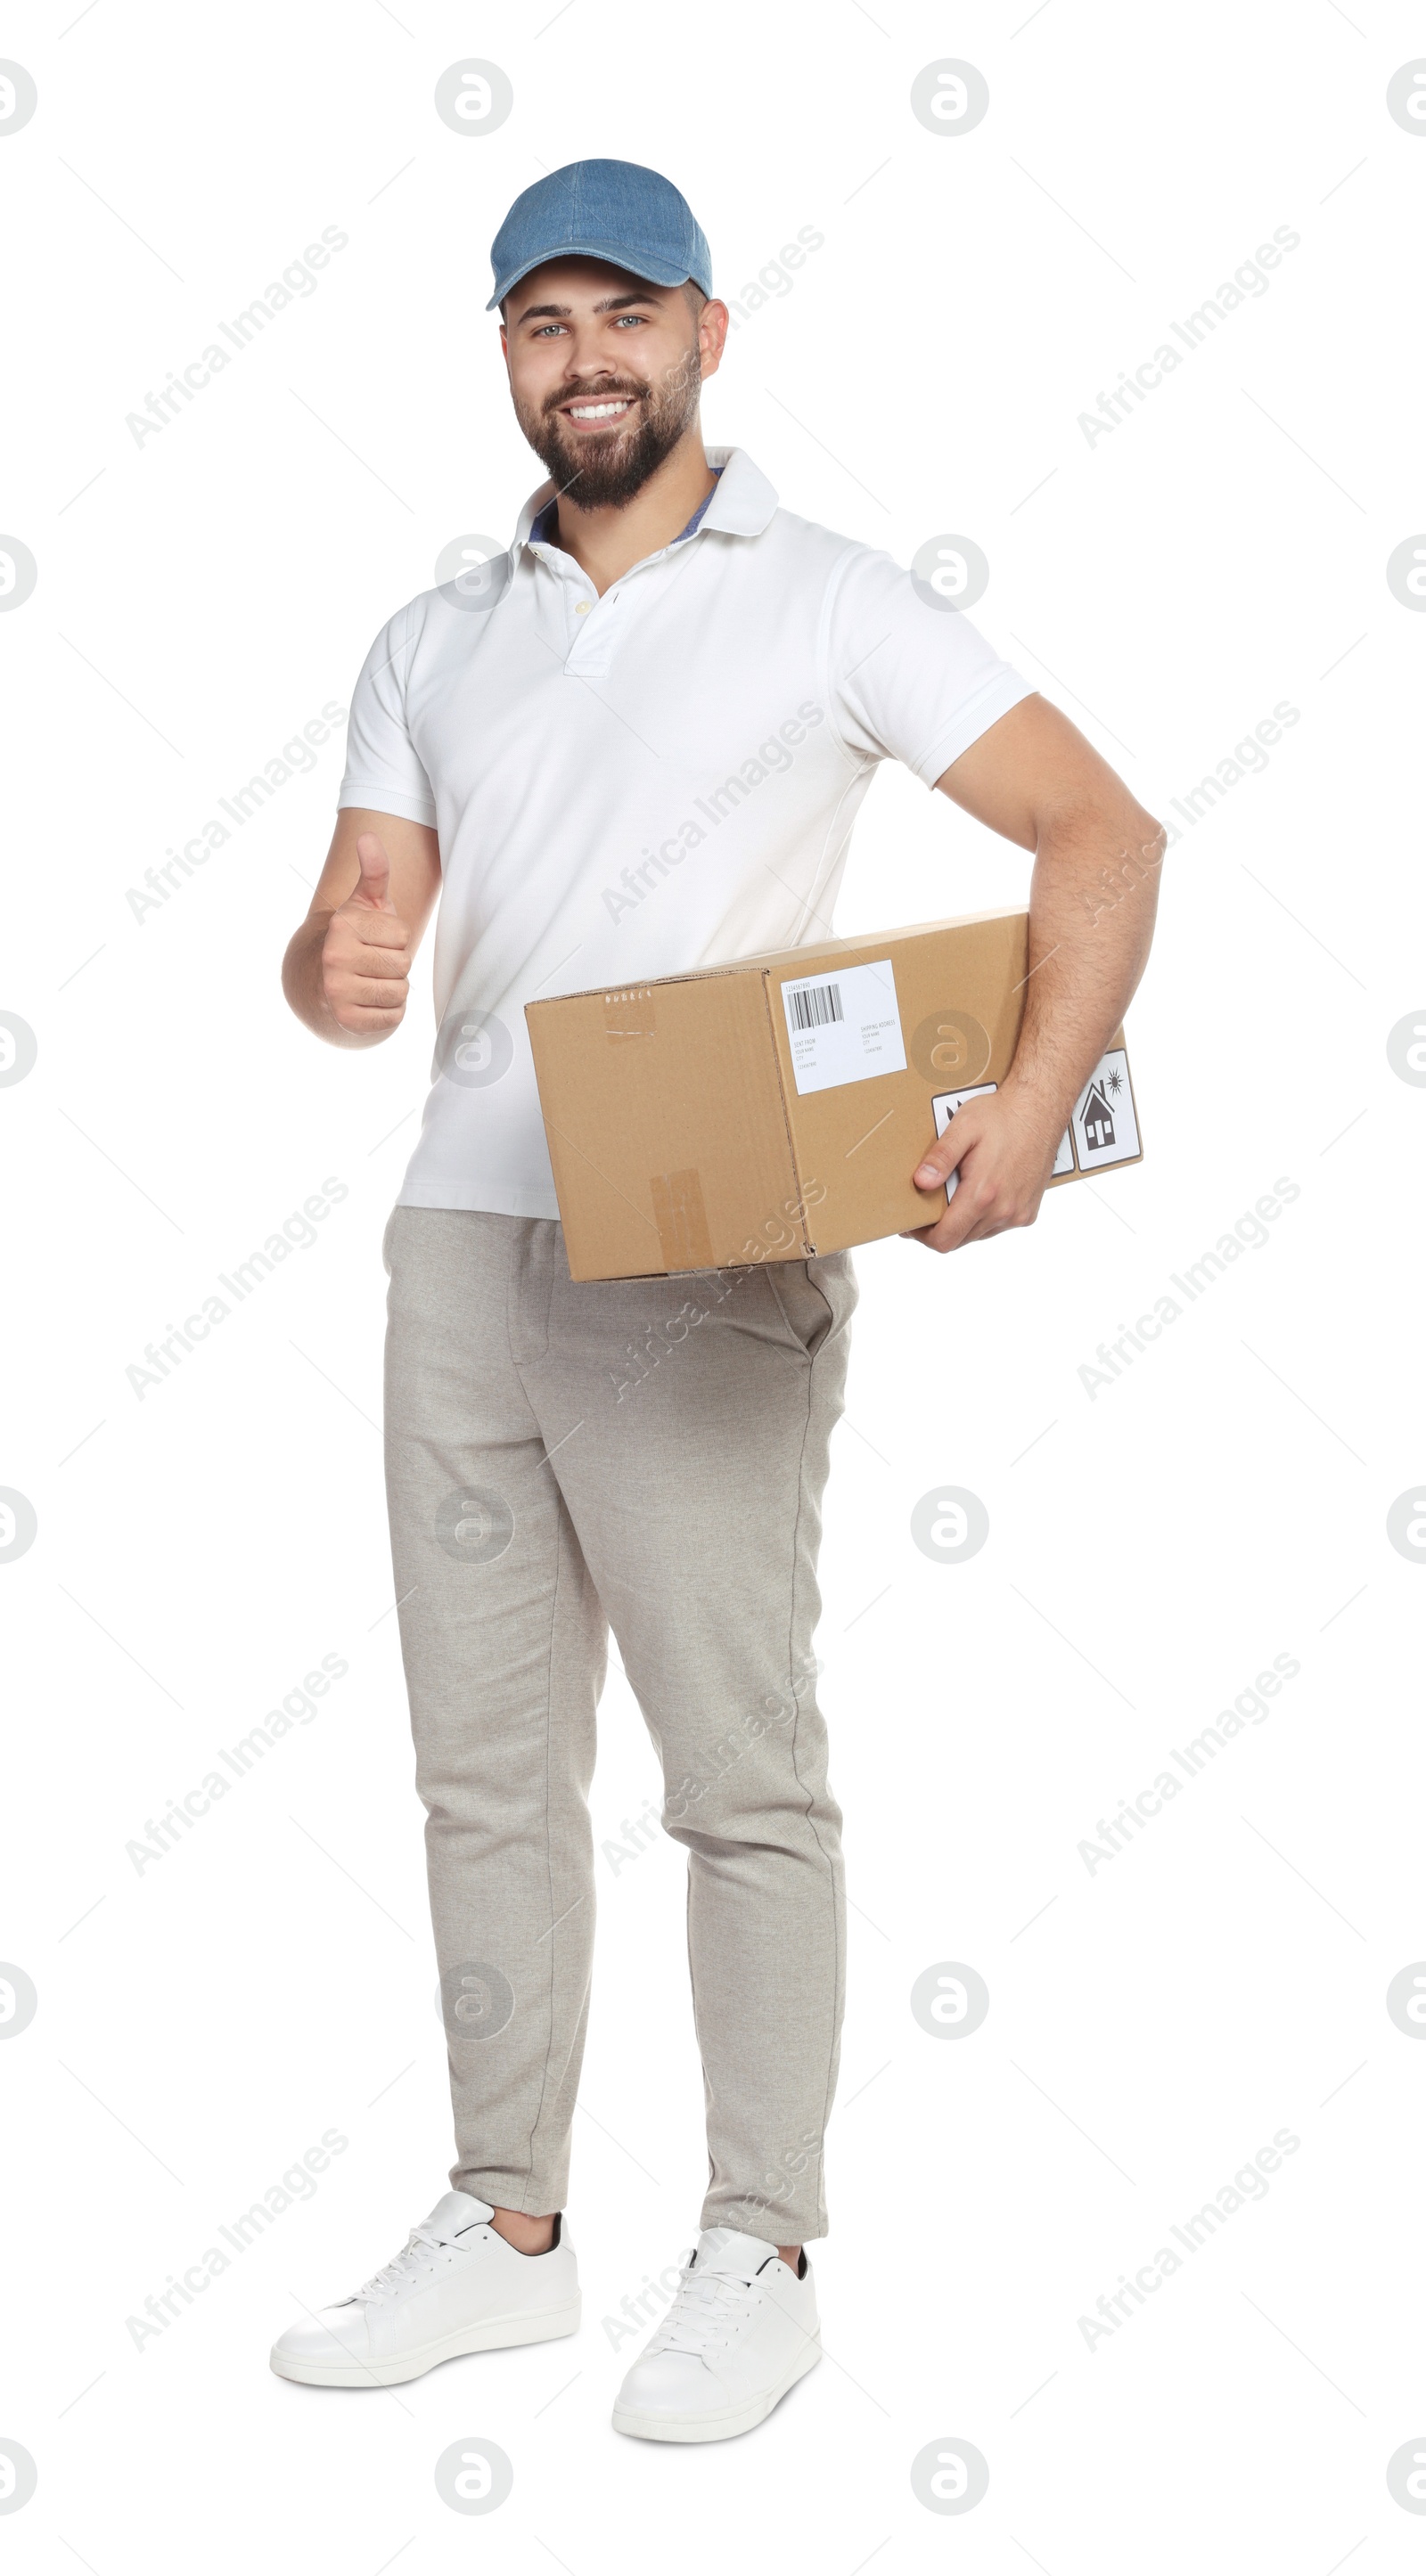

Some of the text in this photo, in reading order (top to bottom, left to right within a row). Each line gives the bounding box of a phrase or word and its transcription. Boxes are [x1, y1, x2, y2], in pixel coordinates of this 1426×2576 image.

[785, 981, 811, 993] 1234567890
[860, 1018, 896, 1032] SHIPPING ADDRESS
[793, 1040, 804, 1048] SENT
